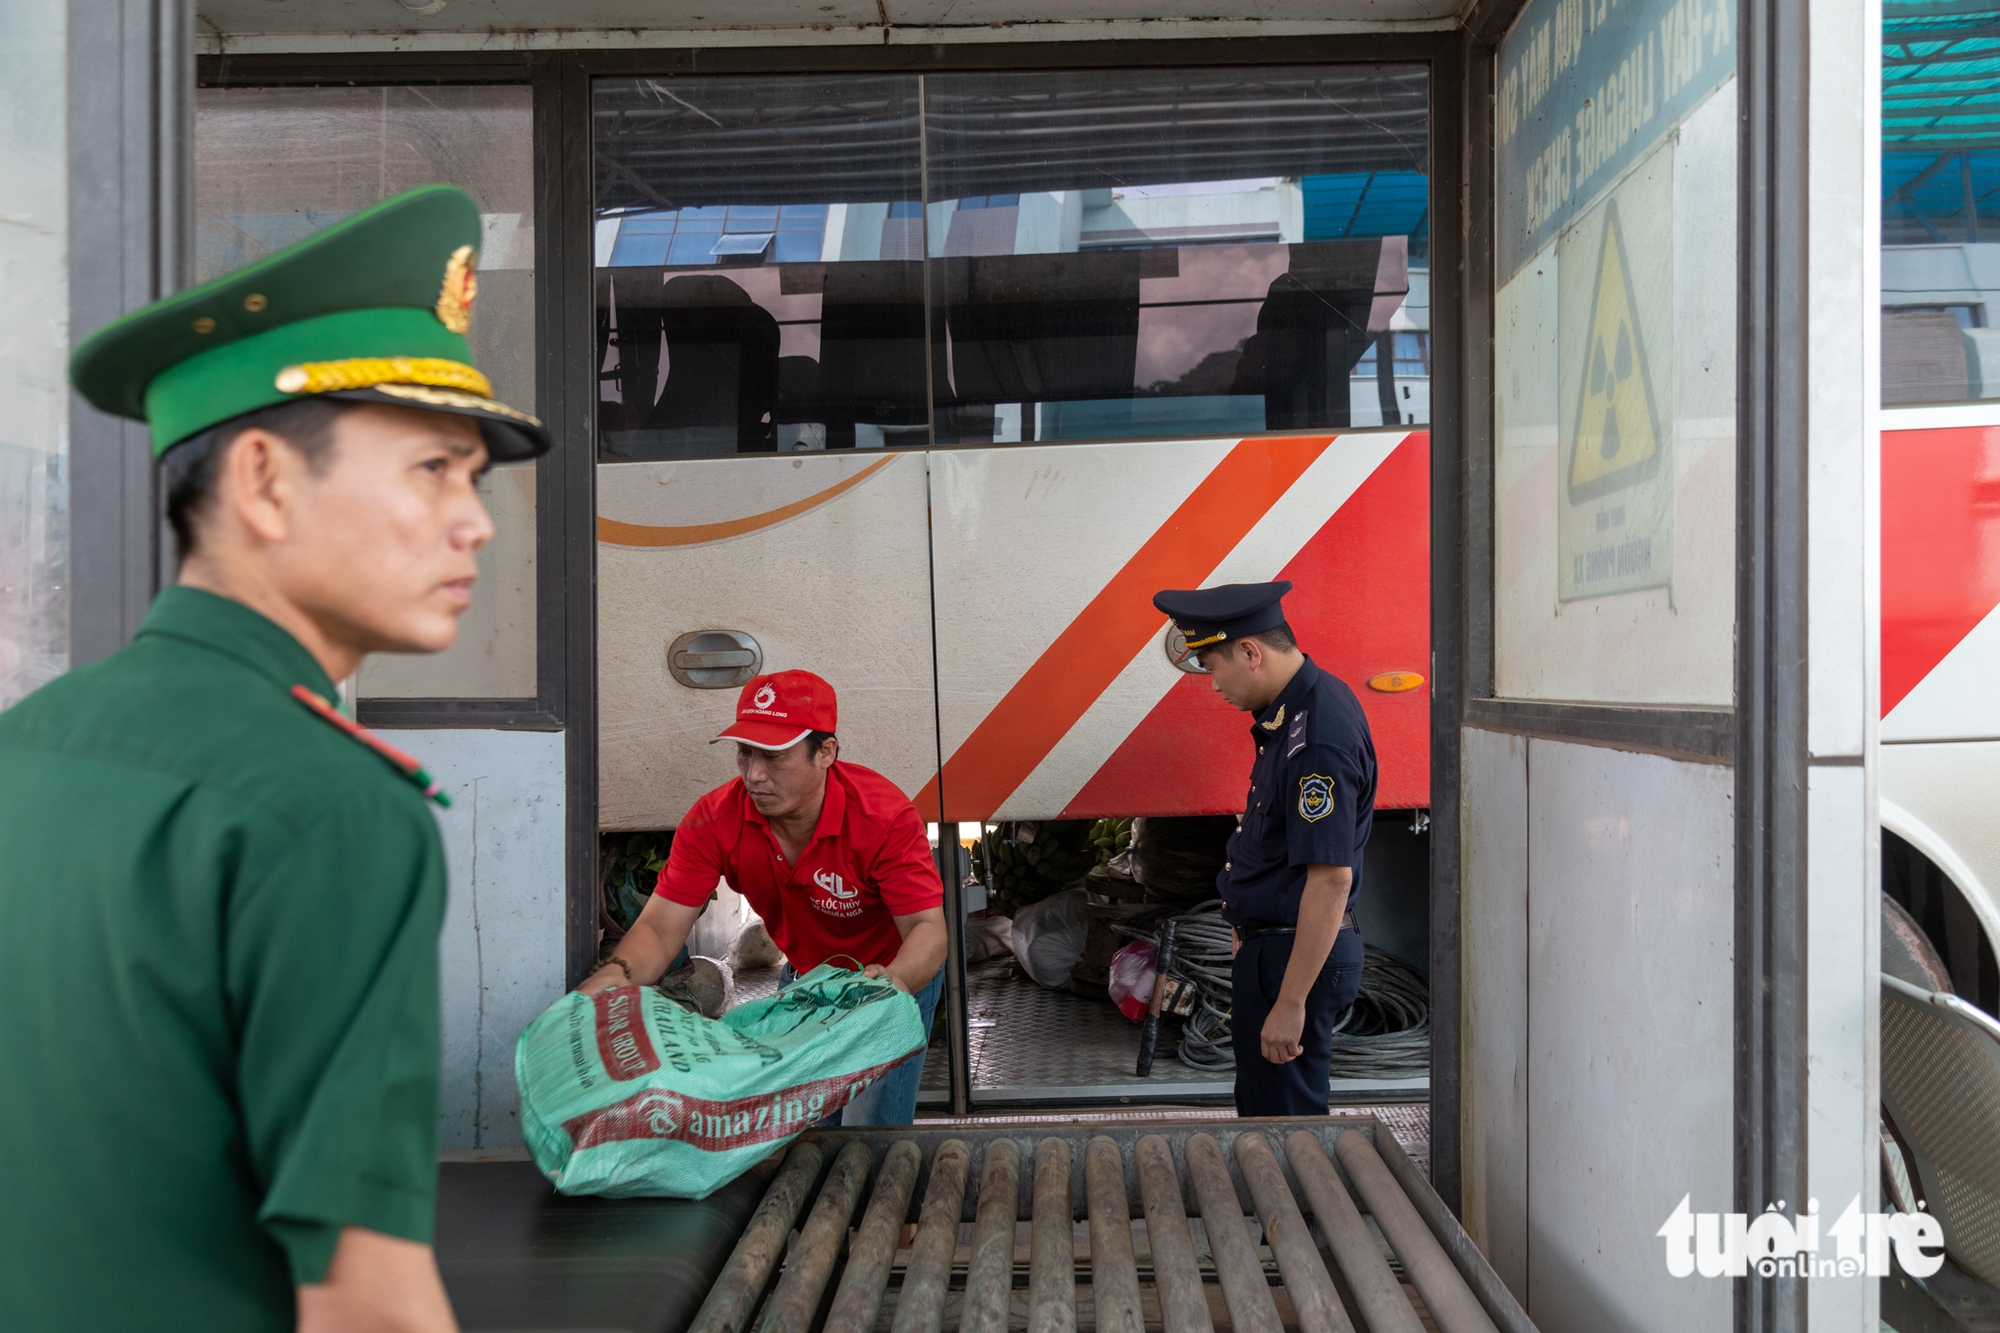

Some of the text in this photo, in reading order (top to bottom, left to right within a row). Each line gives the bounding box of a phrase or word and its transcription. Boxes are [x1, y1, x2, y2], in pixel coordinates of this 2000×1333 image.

[608, 995, 629, 1035] SUGAR
[611, 1031, 646, 1072] GROUP
[689, 1093, 825, 1139] amazing
